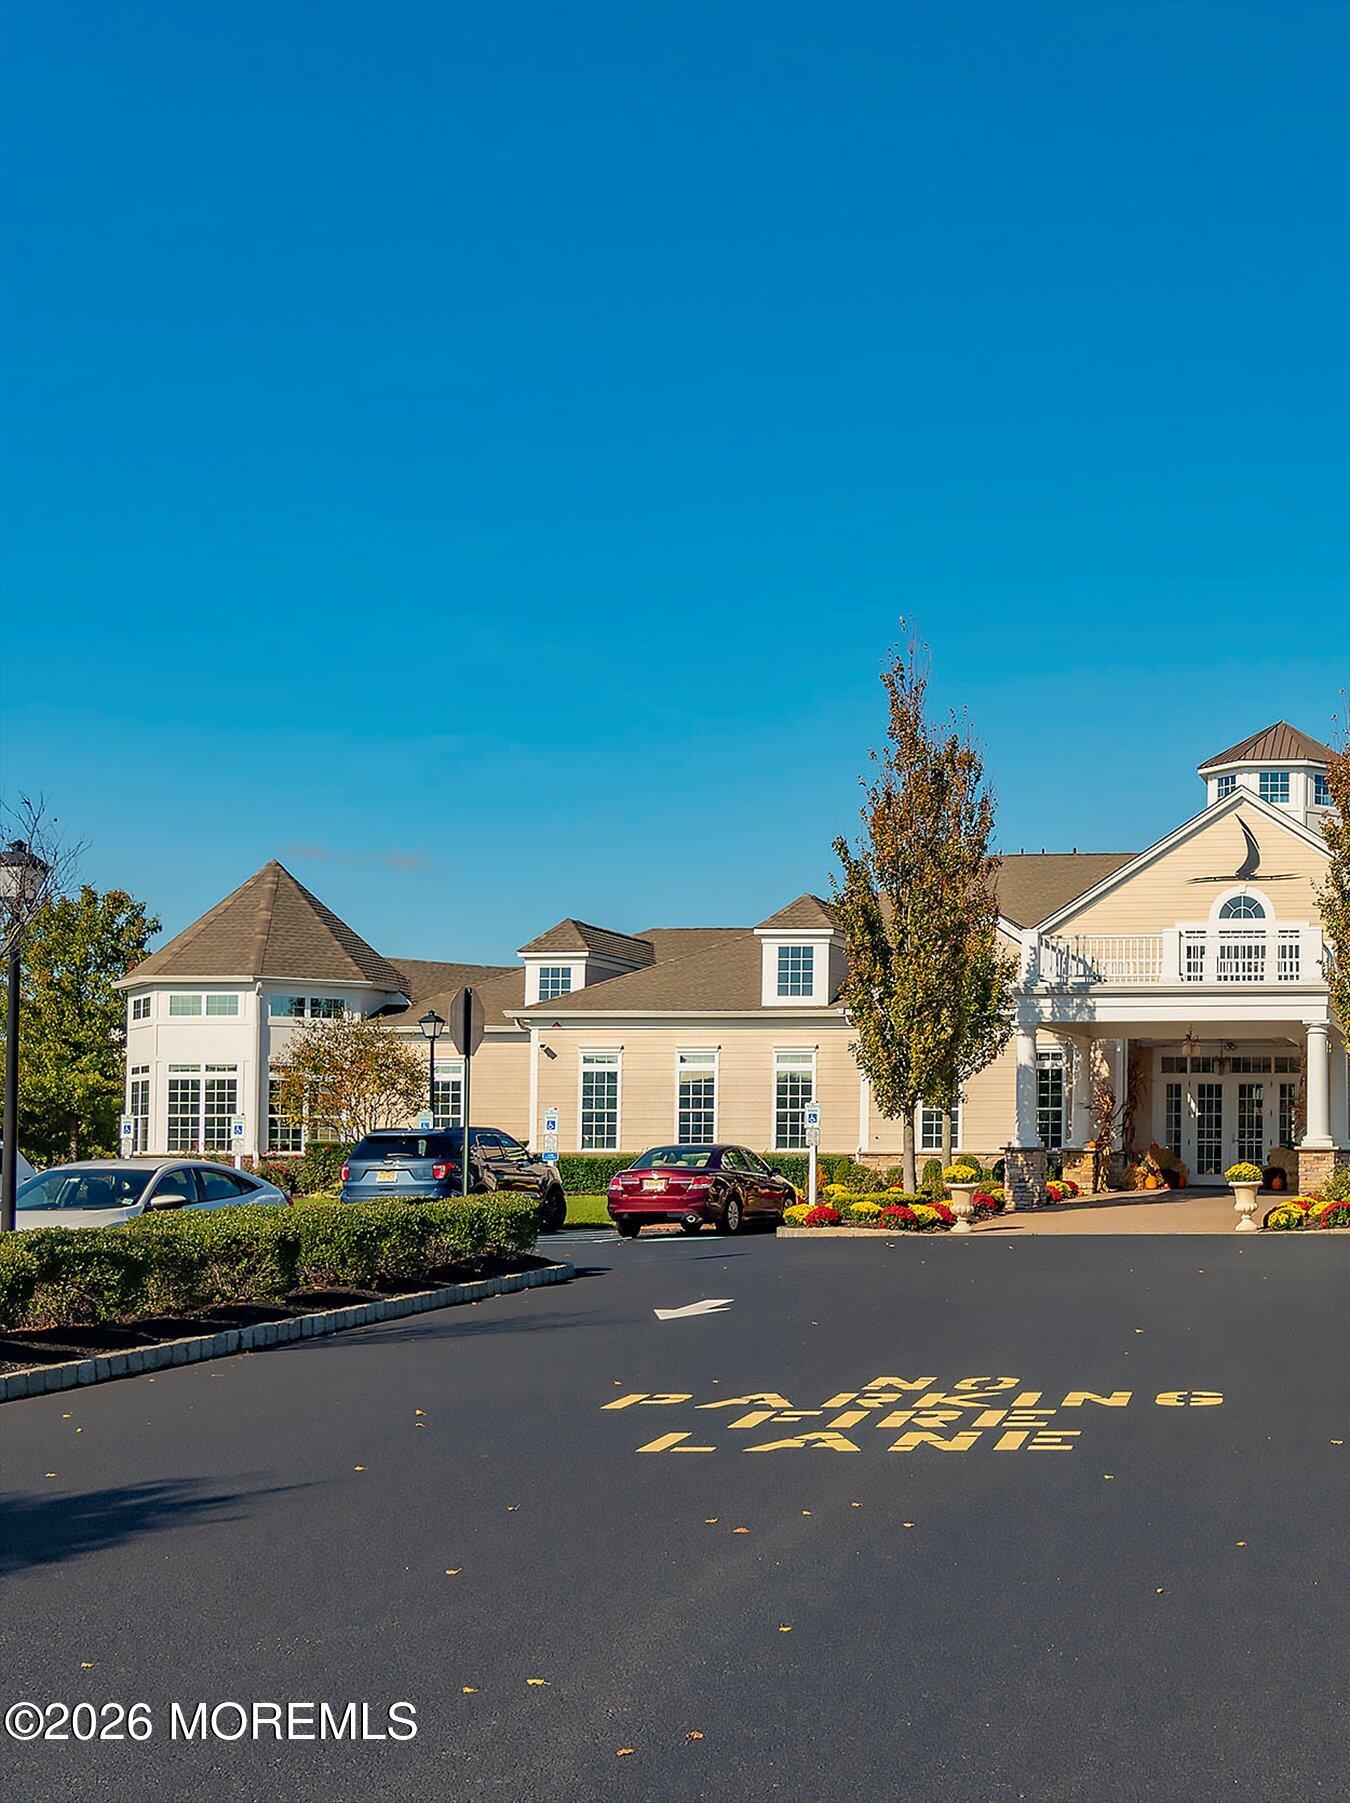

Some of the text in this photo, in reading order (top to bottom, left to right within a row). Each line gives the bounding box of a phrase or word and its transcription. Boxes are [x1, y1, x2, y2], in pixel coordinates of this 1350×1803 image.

[863, 1376, 1020, 1391] NO
[600, 1391, 1224, 1410] PARKING
[727, 1409, 1057, 1429] FIRE
[635, 1430, 1082, 1453] LANE
